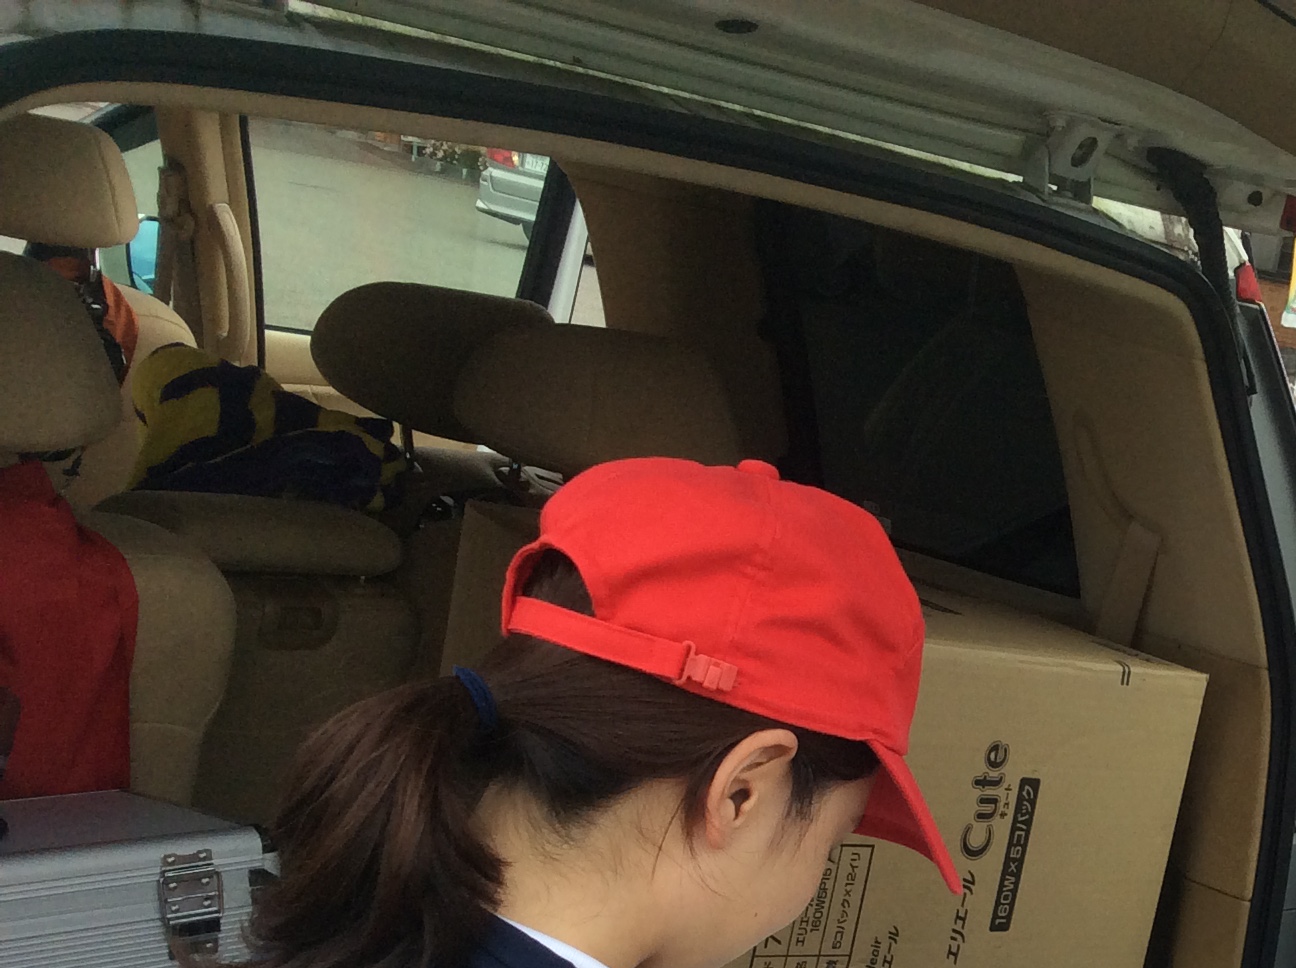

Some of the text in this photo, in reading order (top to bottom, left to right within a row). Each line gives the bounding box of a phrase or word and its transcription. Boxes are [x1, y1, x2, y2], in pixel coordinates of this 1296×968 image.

[960, 740, 1011, 861] Cute
[1000, 785, 1013, 819] キュート
[946, 869, 977, 966] エリエール
